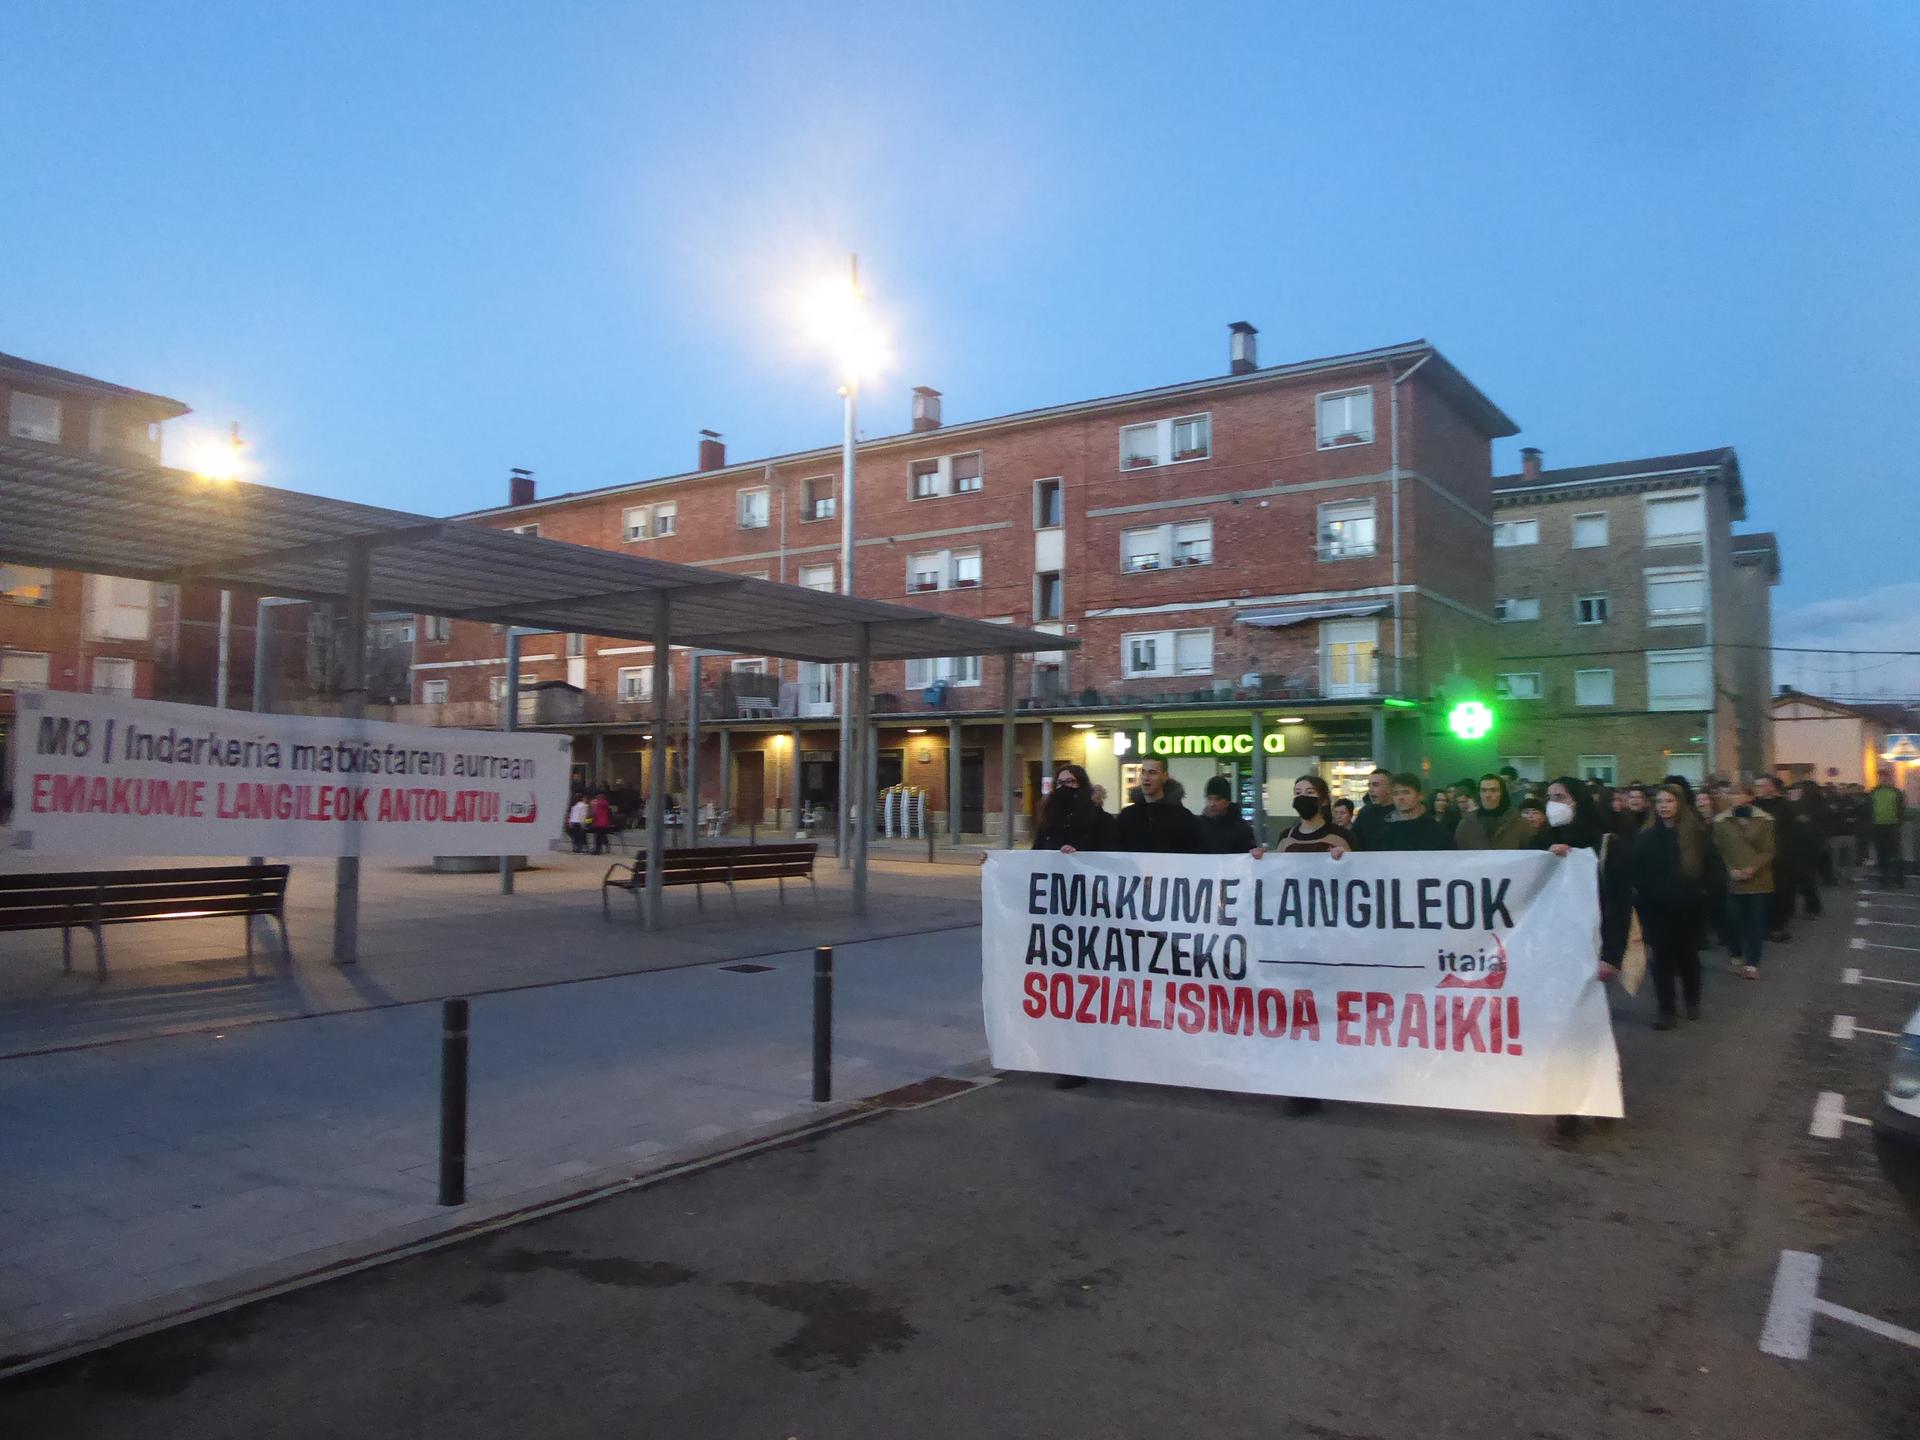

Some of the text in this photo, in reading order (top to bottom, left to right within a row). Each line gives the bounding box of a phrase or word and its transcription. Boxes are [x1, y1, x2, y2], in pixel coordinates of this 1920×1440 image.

[36, 716, 92, 758] M8
[124, 724, 281, 770] Indarkeria
[291, 740, 446, 778] matxistaren
[452, 753, 537, 780] aurrean
[1137, 731, 1286, 755] armaca
[31, 773, 500, 823] EMAKUME LANGILEOK ANTOLATU!
[1028, 872, 1515, 931] EMAKUME LANGILEOK
[1025, 923, 1248, 981] ASKATZEKO
[1438, 948, 1505, 974] itaia
[1022, 971, 1524, 1057] SOZIALISMOA ERAIKI!
